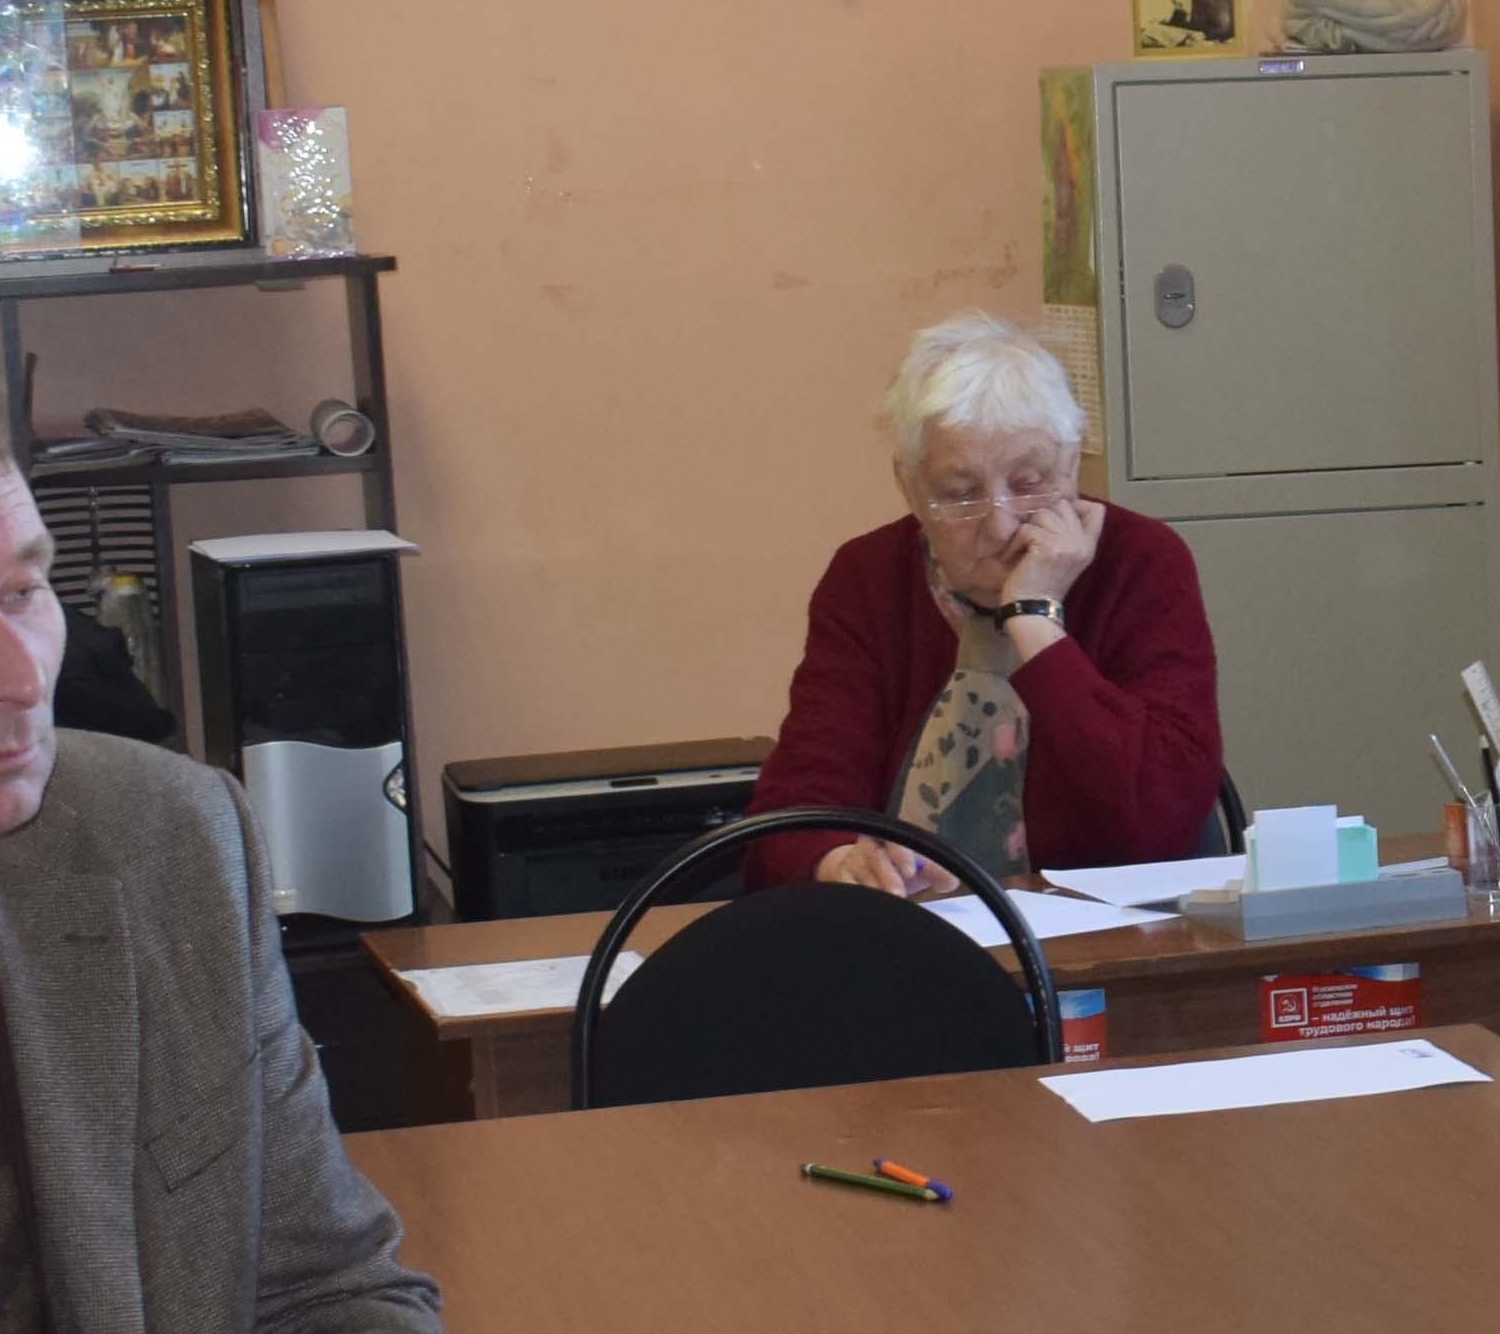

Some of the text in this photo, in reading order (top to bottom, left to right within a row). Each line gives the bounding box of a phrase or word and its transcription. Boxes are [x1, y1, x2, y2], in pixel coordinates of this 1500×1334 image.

[1323, 1005, 1387, 1022] надёжный
[1389, 1004, 1414, 1017] щит
[1298, 1014, 1417, 1039] трудового народа!
